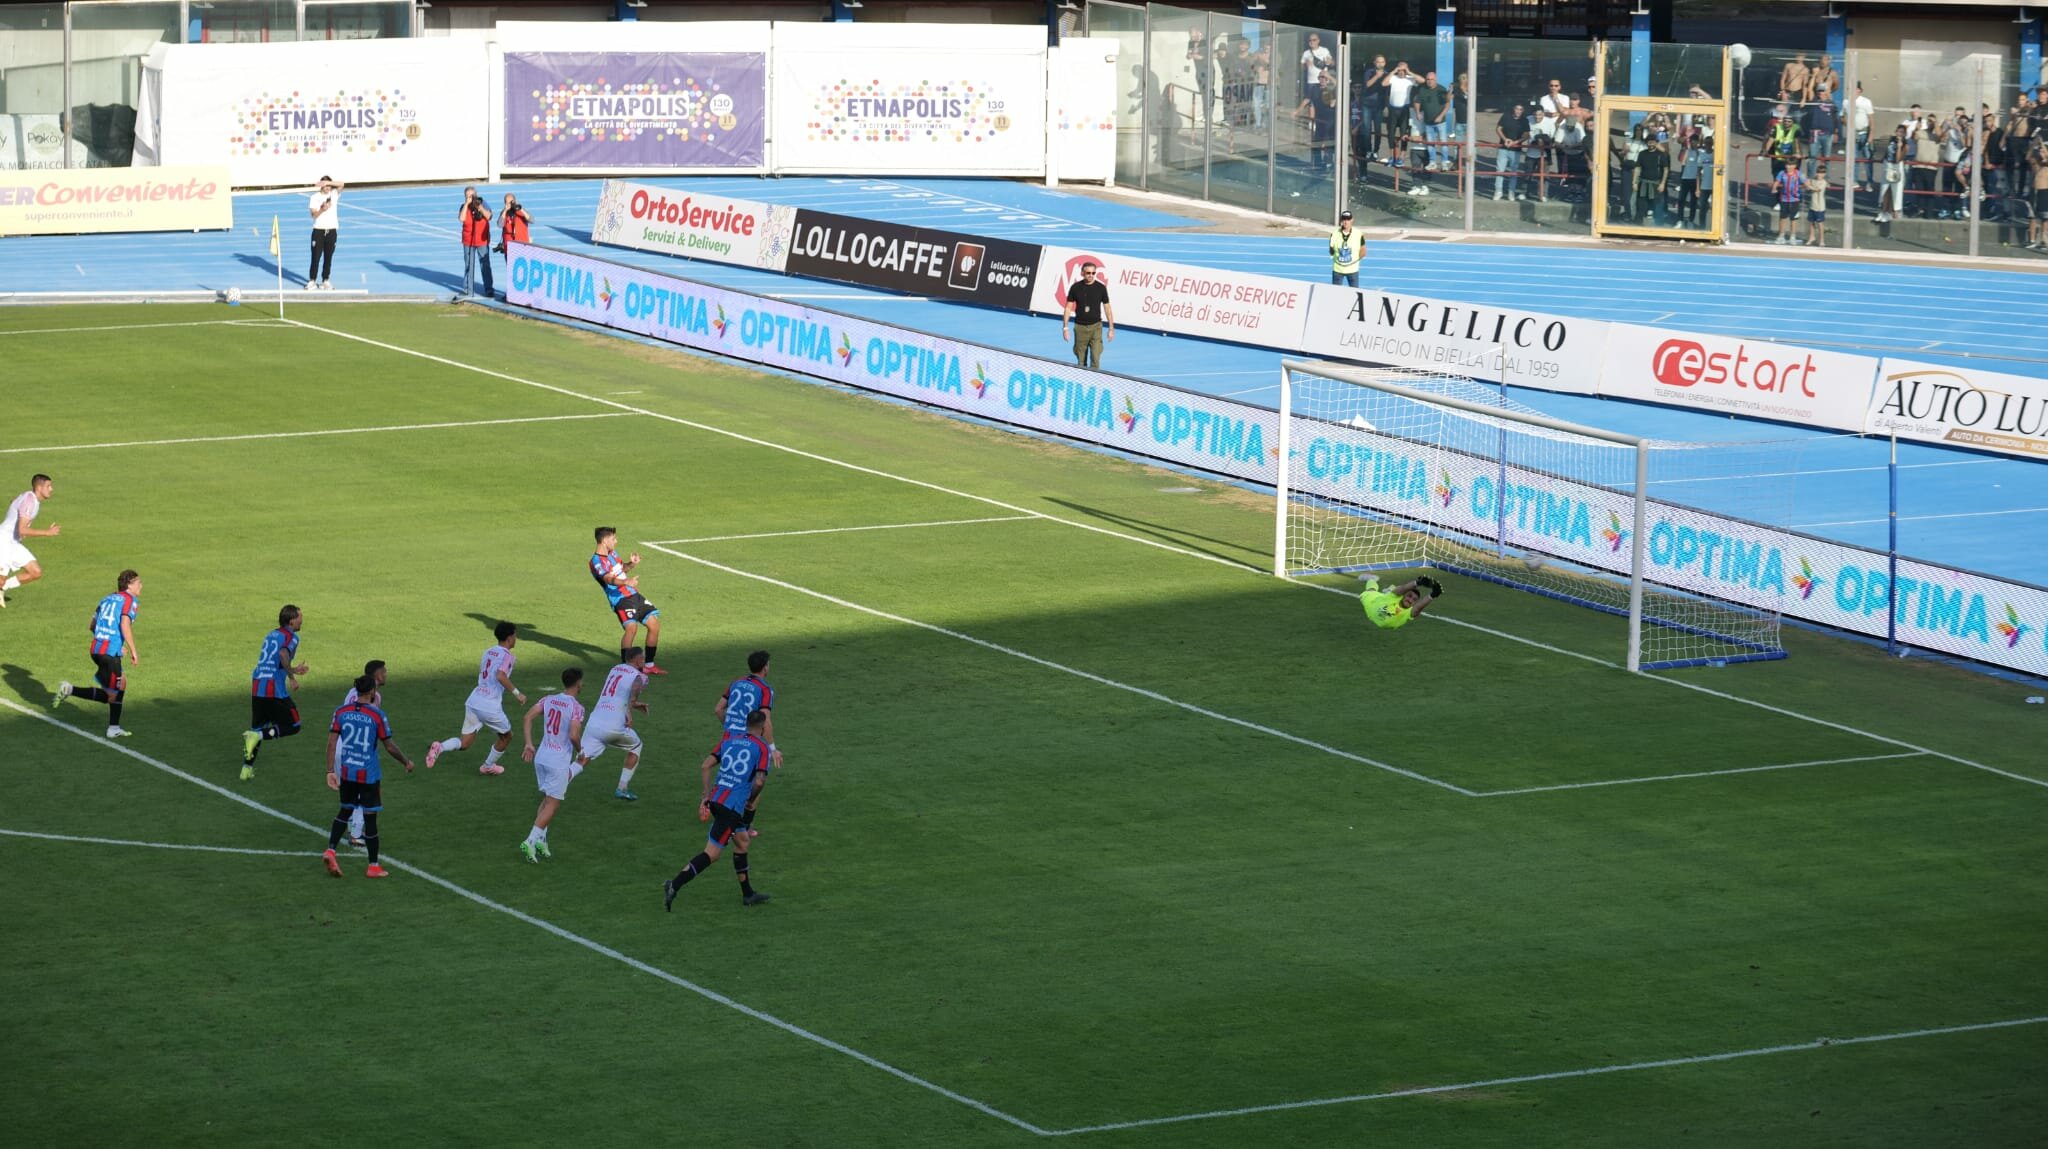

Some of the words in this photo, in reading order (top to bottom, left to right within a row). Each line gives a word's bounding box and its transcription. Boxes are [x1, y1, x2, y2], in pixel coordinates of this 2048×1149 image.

[269, 108, 376, 130] ETNAPOLIS
[573, 98, 688, 116] ETNAPOLIS
[848, 98, 962, 118] ETNAPOLIS
[988, 100, 1005, 110] 130
[9, 160, 76, 170] MONFALCOE
[25, 209, 134, 224] superconveniente.it
[630, 190, 754, 236] OrtoService
[642, 226, 675, 244] Servizi
[678, 232, 686, 246] &
[688, 234, 731, 256] Delivery
[512, 256, 596, 308] OPTIMA
[990, 260, 1030, 275] lollocaffe.it
[1120, 270, 1153, 288] NEW
[1154, 274, 1232, 300] SPLENDOR
[1234, 284, 1298, 309] SERVICE
[624, 282, 709, 336] OPTIMA
[1142, 296, 1193, 320] Società
[1197, 303, 1210, 322] di
[1213, 308, 1261, 328] servizi
[1346, 292, 1566, 351] ANGELICO
[740, 309, 832, 365] OPTIMA
[1340, 331, 1410, 357] LANIFICIO
[1414, 344, 1430, 362] IN
[1434, 346, 1484, 368] BIELLA
[1494, 354, 1523, 374] DAL
[1528, 359, 1560, 378] 1959
[866, 337, 962, 395] OPTIMA
[1654, 340, 1816, 398] restart
[1008, 370, 1114, 432] OPTIMA
[1878, 380, 1987, 426] AUTO
[1152, 402, 1265, 467] OPTIMA
[1951, 432, 1970, 442] AUTO
[1307, 436, 1428, 505] OPTIMA
[1472, 476, 1592, 548] OPTIMA
[1649, 520, 1785, 595] OPTIMA
[1834, 565, 1990, 644] OPTIMA
[258, 639, 278, 664] 32
[602, 674, 623, 697] 14
[726, 688, 756, 719] 23
[341, 722, 370, 752] 24
[546, 707, 561, 736] 20
[719, 746, 751, 776] 68
